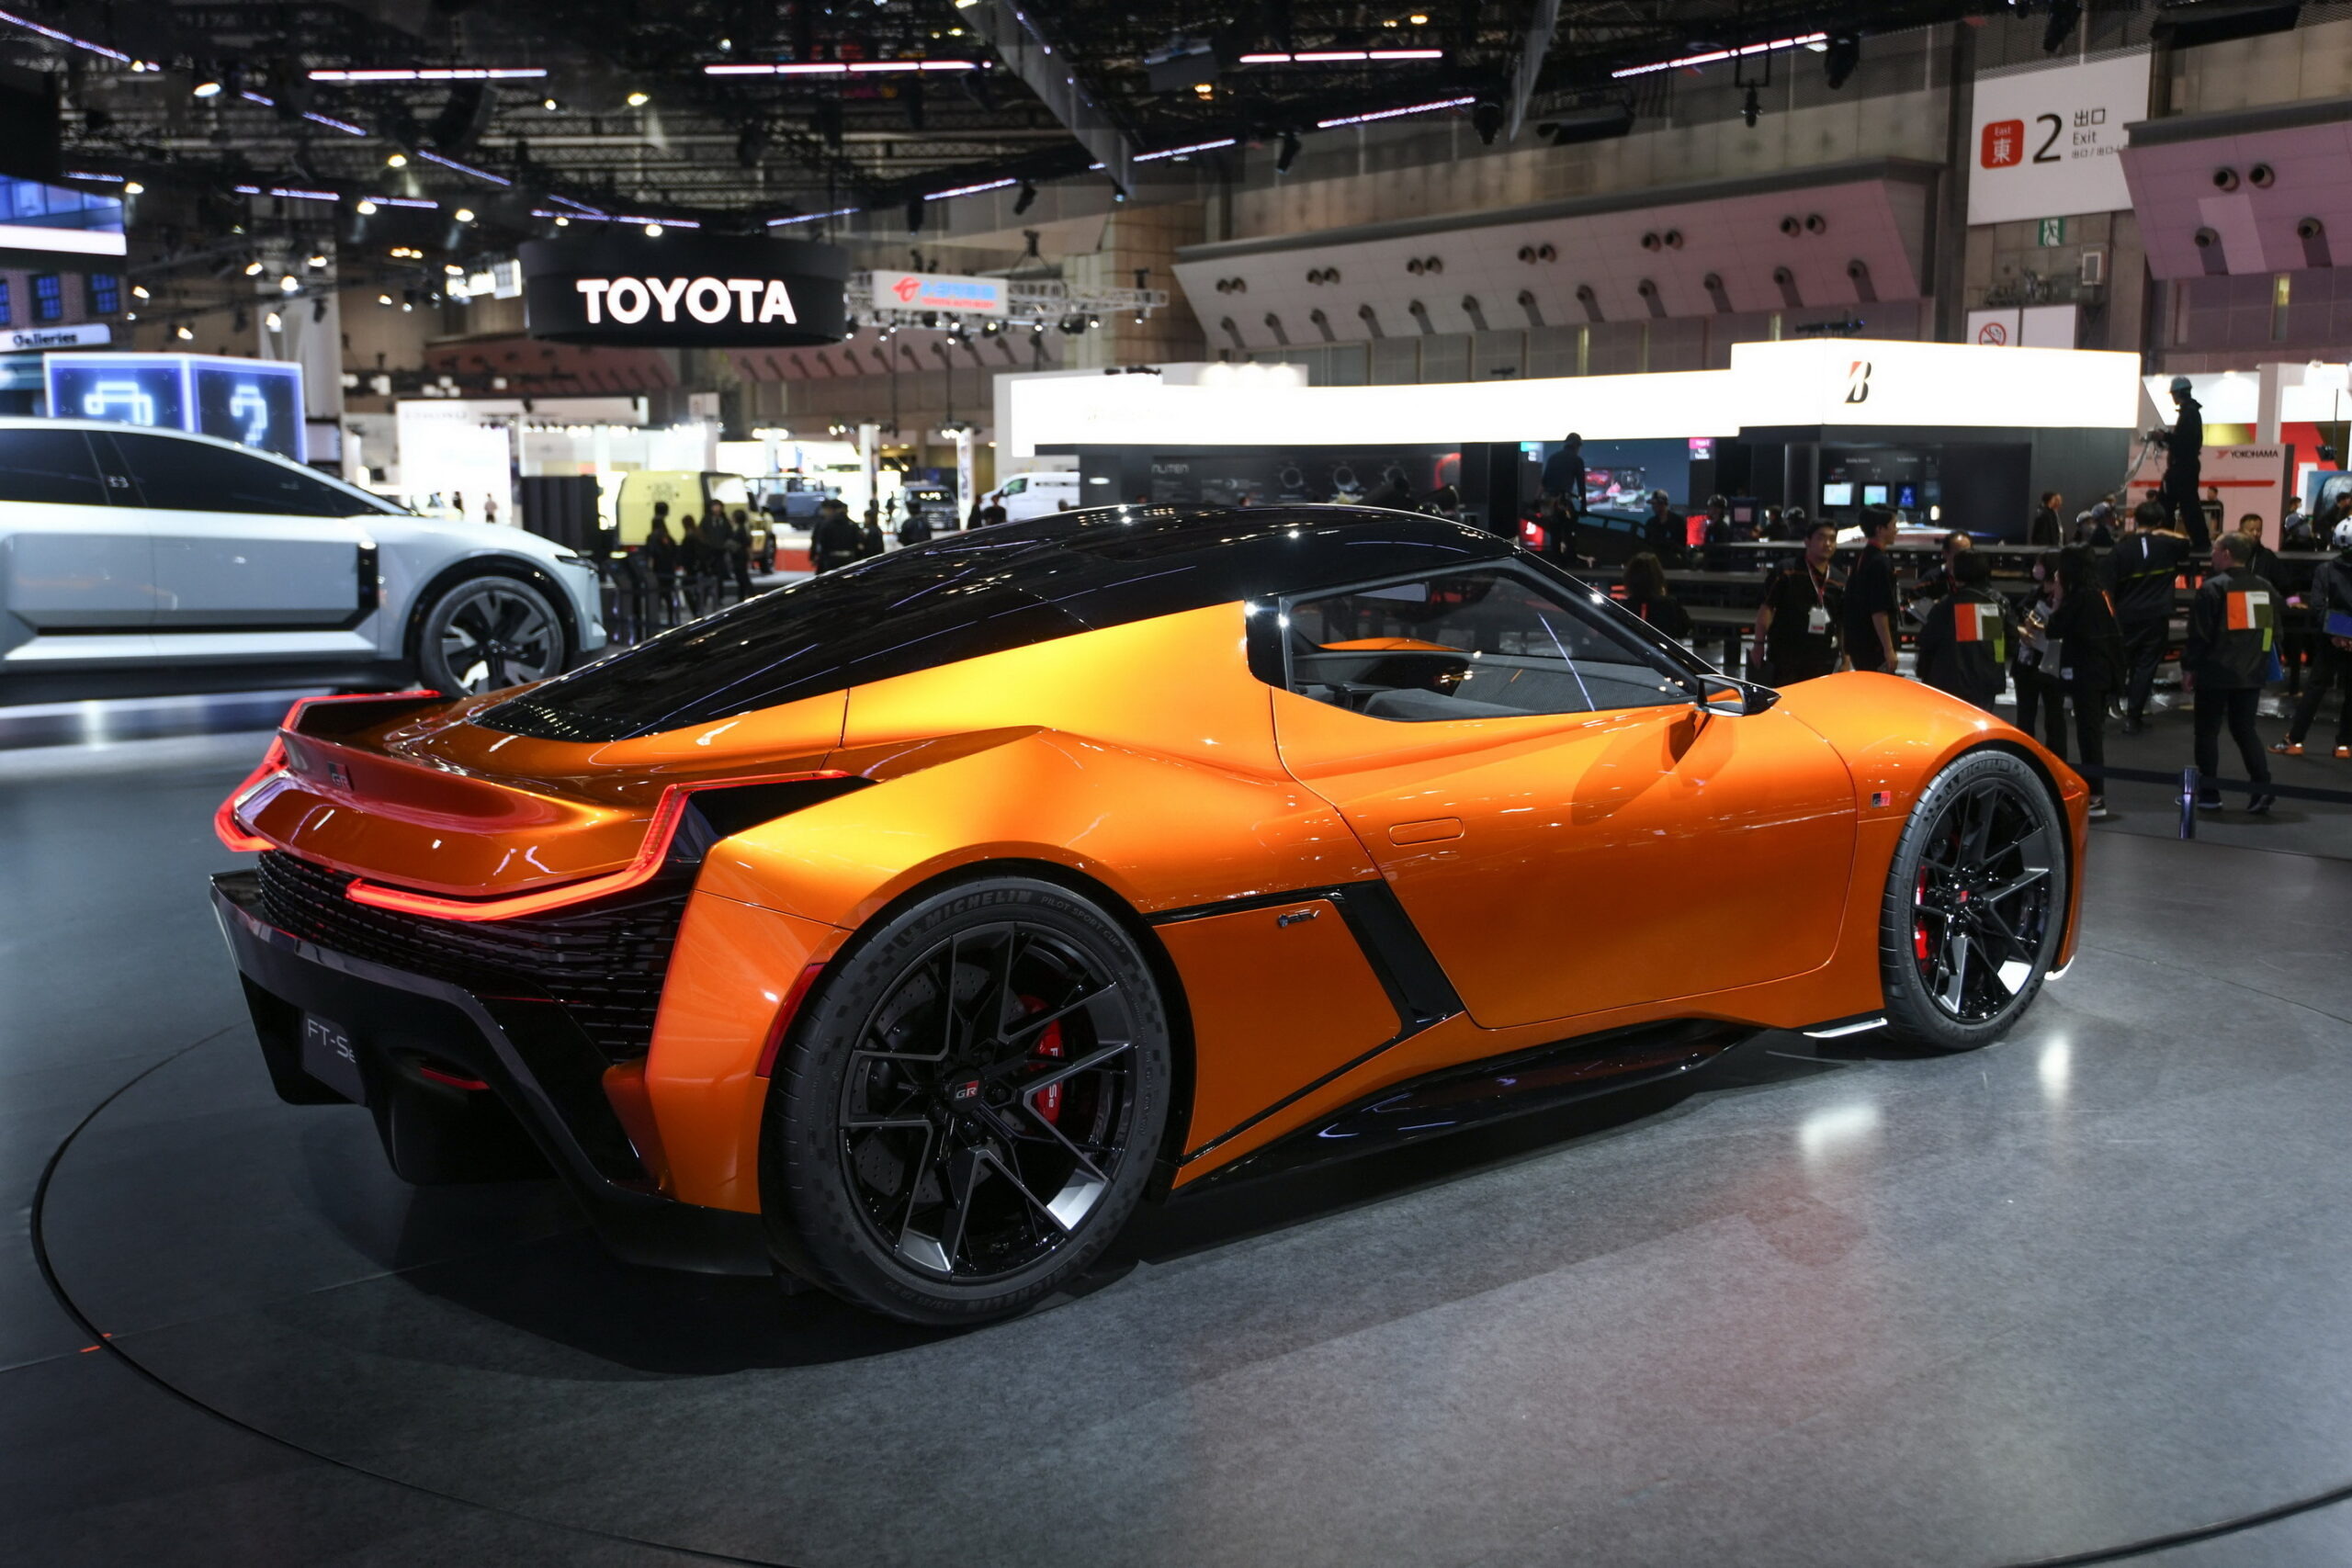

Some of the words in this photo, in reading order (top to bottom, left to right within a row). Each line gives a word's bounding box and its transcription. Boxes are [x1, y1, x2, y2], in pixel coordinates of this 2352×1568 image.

[2074, 107, 2106, 128] 出口
[1994, 125, 2012, 137] East
[2033, 113, 2062, 164] 2
[2073, 129, 2097, 146] Exit
[1992, 138, 2013, 164] 東
[576, 276, 797, 323] TOYOTA
[2230, 449, 2278, 458] YOKOHAMA
[926, 890, 1033, 929] MICHELIN
[1041, 896, 1071, 911] PILOT
[1073, 908, 1102, 930] SPORT
[1103, 929, 1121, 948] CUP
